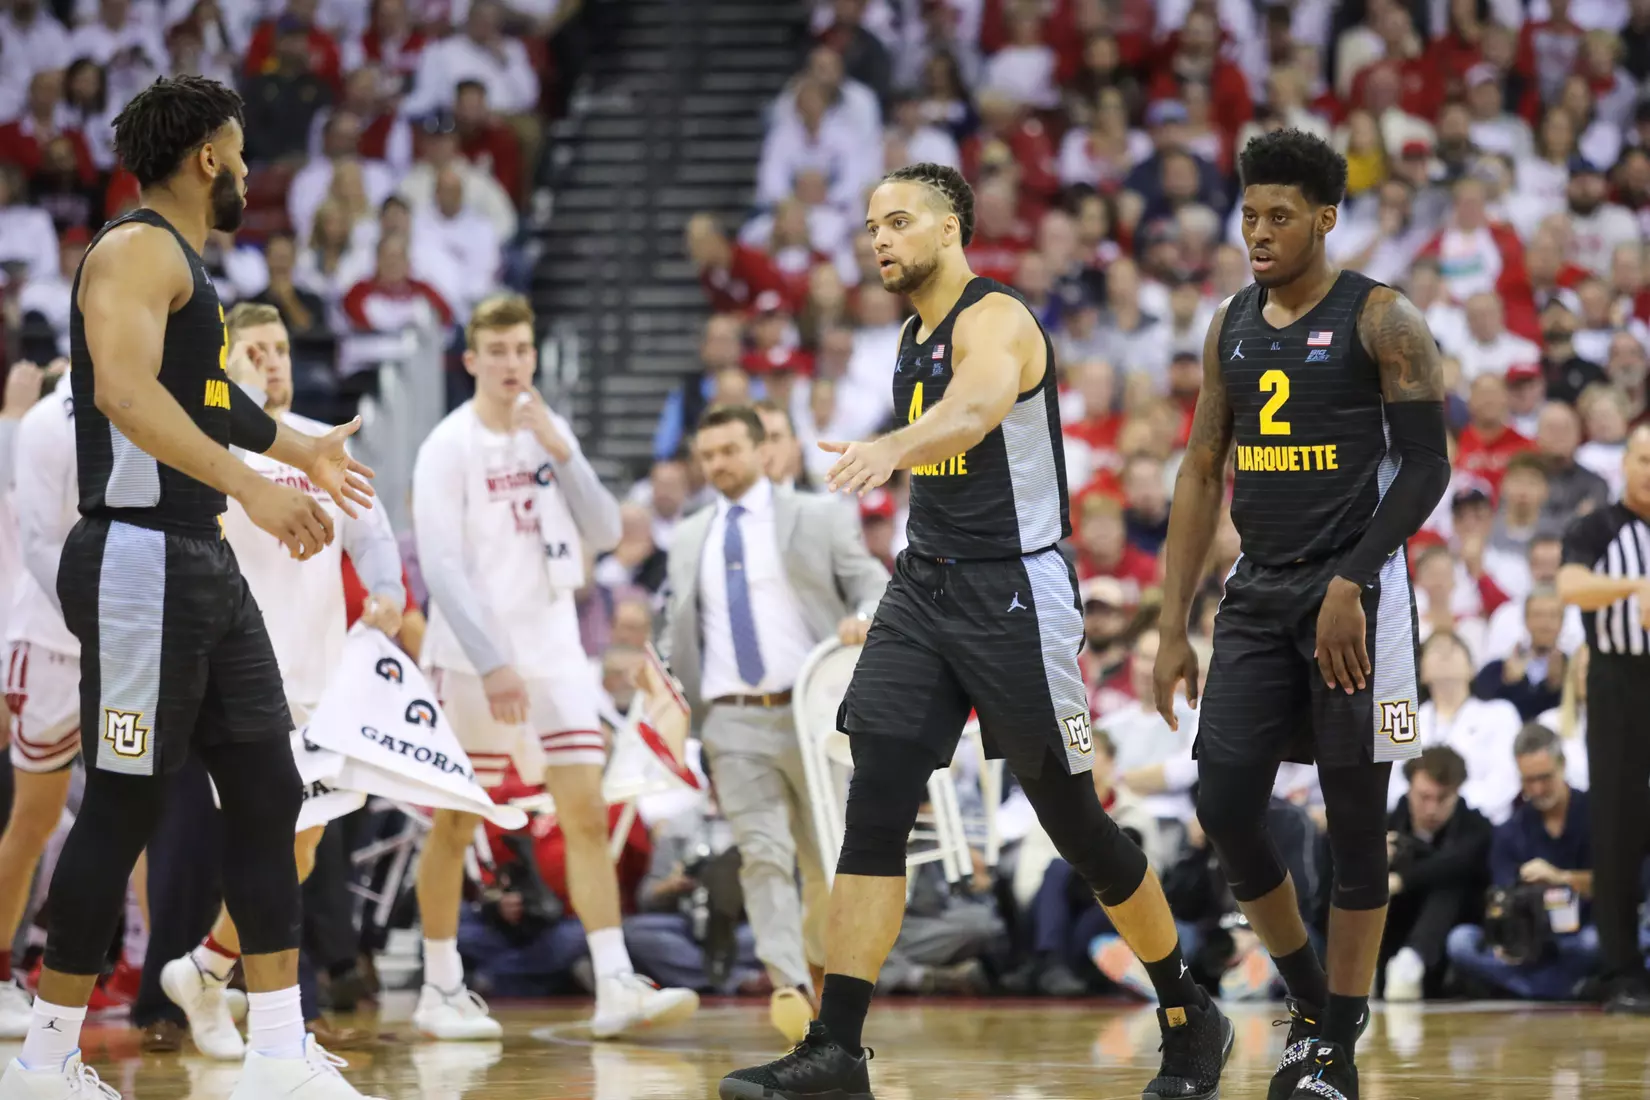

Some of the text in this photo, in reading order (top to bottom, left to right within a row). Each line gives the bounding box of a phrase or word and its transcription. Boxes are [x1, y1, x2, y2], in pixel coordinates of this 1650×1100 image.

[908, 381, 924, 425] 4
[1259, 369, 1291, 435] 2
[1237, 444, 1339, 471] MARQUETTE
[360, 725, 476, 782] GATORA
